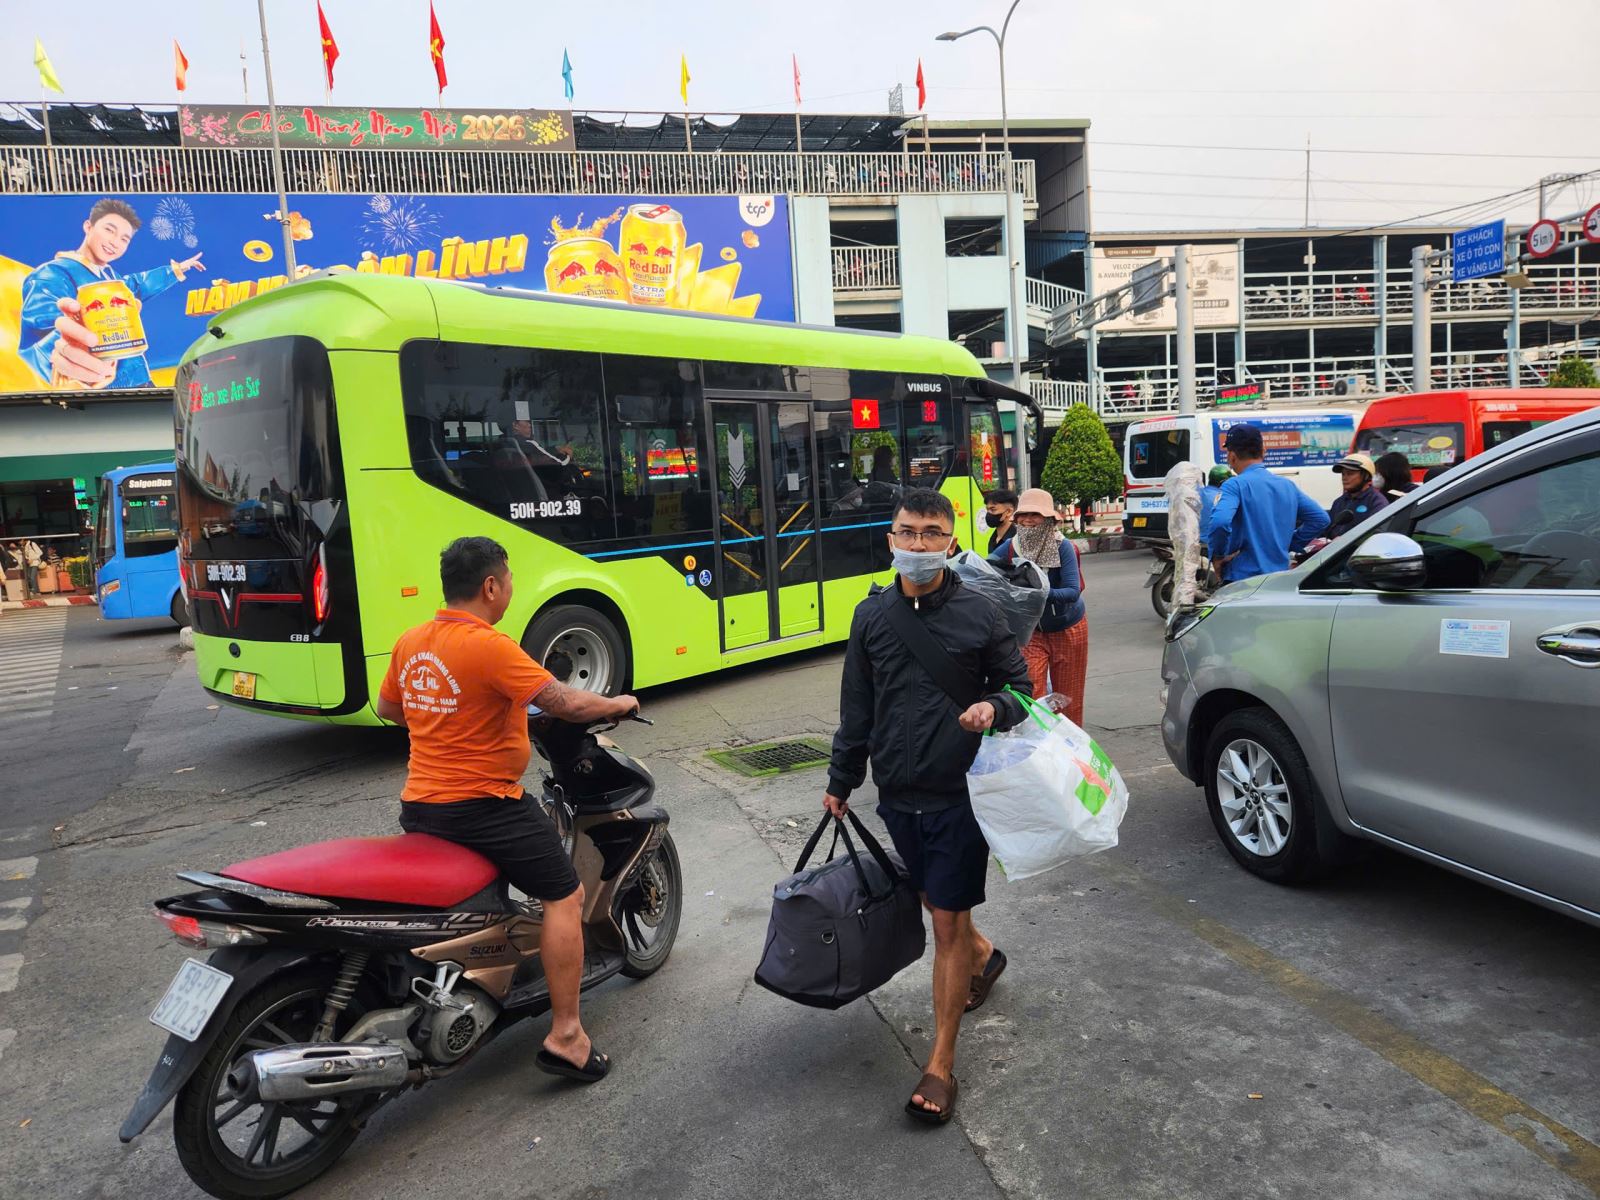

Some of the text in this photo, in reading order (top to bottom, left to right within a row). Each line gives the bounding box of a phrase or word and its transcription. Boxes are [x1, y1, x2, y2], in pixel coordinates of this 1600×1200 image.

[461, 114, 526, 141] 2026
[746, 202, 766, 218] tcp
[1456, 229, 1494, 247] XE KHÁCH
[1533, 234, 1539, 247] 5
[328, 234, 529, 280] ẢN LĨNH
[1456, 251, 1466, 263] XE
[1484, 243, 1500, 255] CON
[629, 257, 672, 275] Red Bull
[1456, 267, 1466, 278] XE
[1488, 258, 1501, 270] LAI
[633, 283, 665, 293] EXTRA
[907, 382, 942, 393] VINBUS
[922, 400, 937, 422] 33
[129, 479, 172, 489] SaigonBus
[510, 500, 581, 519] 50H-902.39
[206, 564, 246, 581] 50H-902.39
[446, 674, 461, 695] LONG
[417, 694, 436, 704] TRUNG
[440, 698, 457, 706] NAM
[470, 942, 507, 955] SUZUKI
